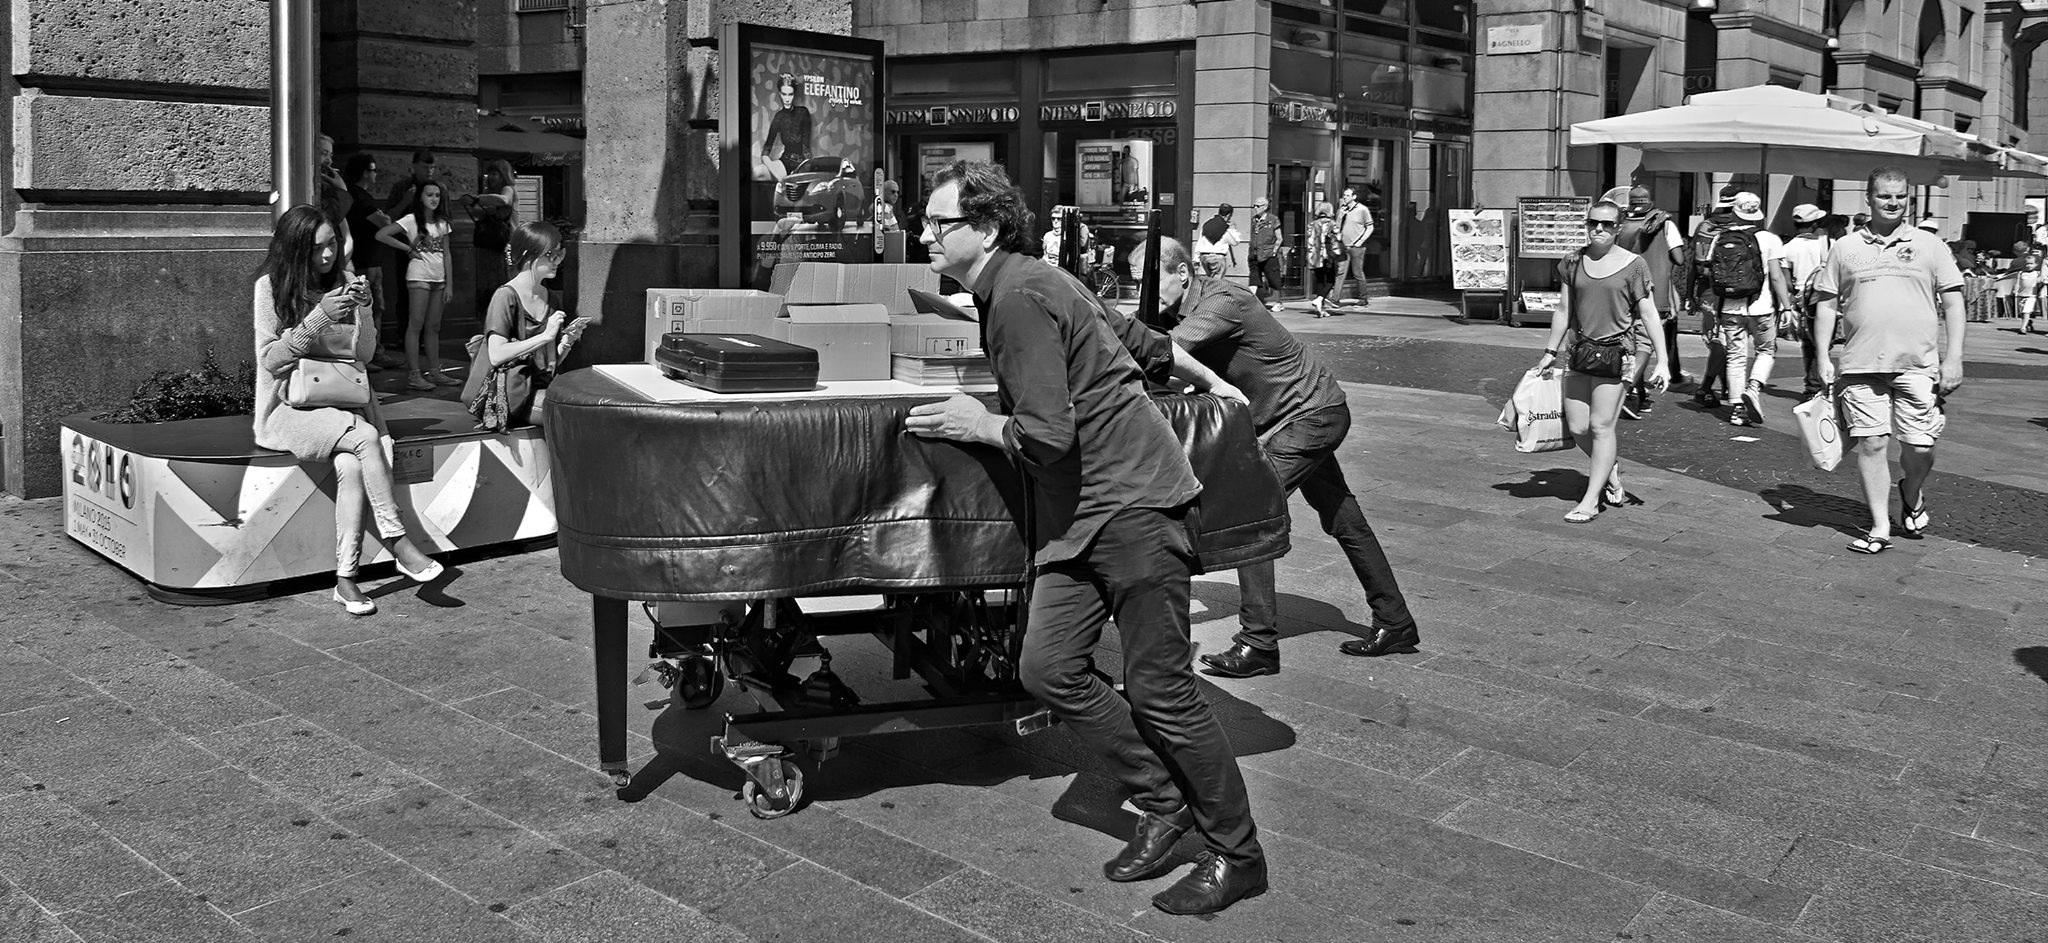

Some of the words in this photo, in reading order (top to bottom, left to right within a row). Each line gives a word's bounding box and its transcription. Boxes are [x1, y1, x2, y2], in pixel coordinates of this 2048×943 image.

[803, 74, 825, 83] YPSILON
[803, 82, 860, 100] ELEFANTINO
[1104, 100, 1177, 119] SANPAOLO
[73, 499, 97, 524] MILANO
[99, 533, 128, 561] OCTOBER
